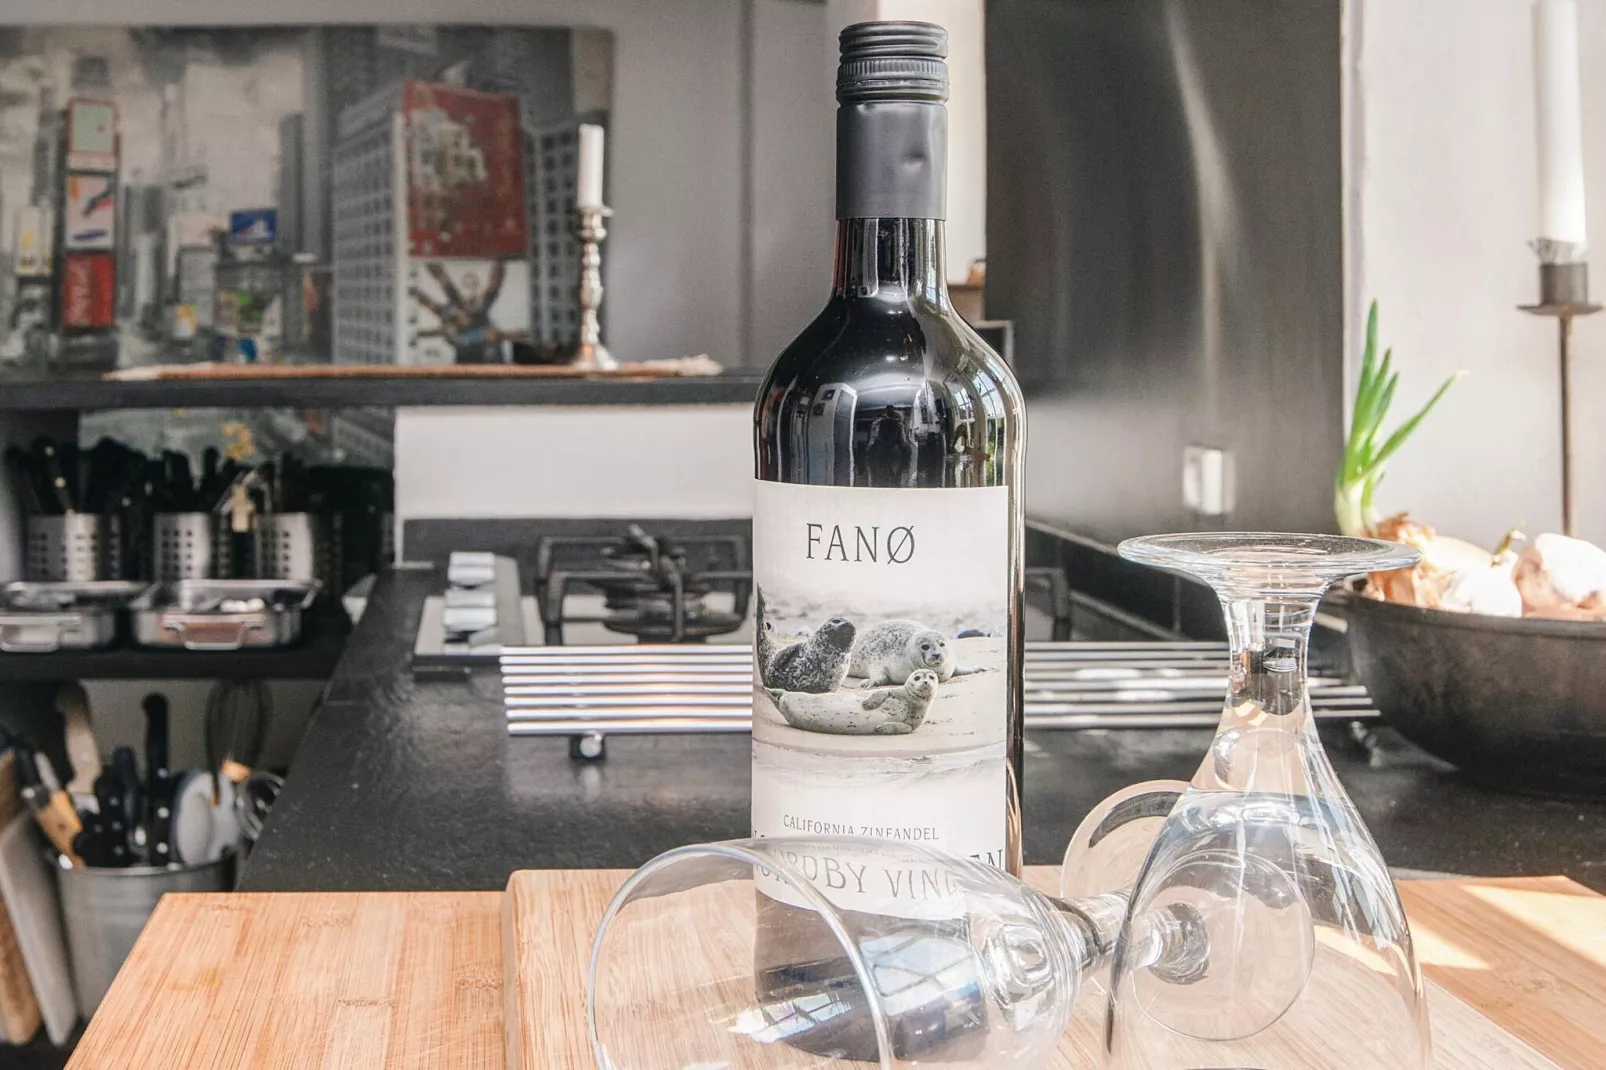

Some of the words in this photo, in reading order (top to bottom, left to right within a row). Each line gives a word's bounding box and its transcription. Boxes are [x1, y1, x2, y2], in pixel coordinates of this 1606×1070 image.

[805, 522, 915, 564] FANØ
[783, 815, 854, 835] CALIFORNIA
[860, 826, 940, 841] ZINFANDEL
